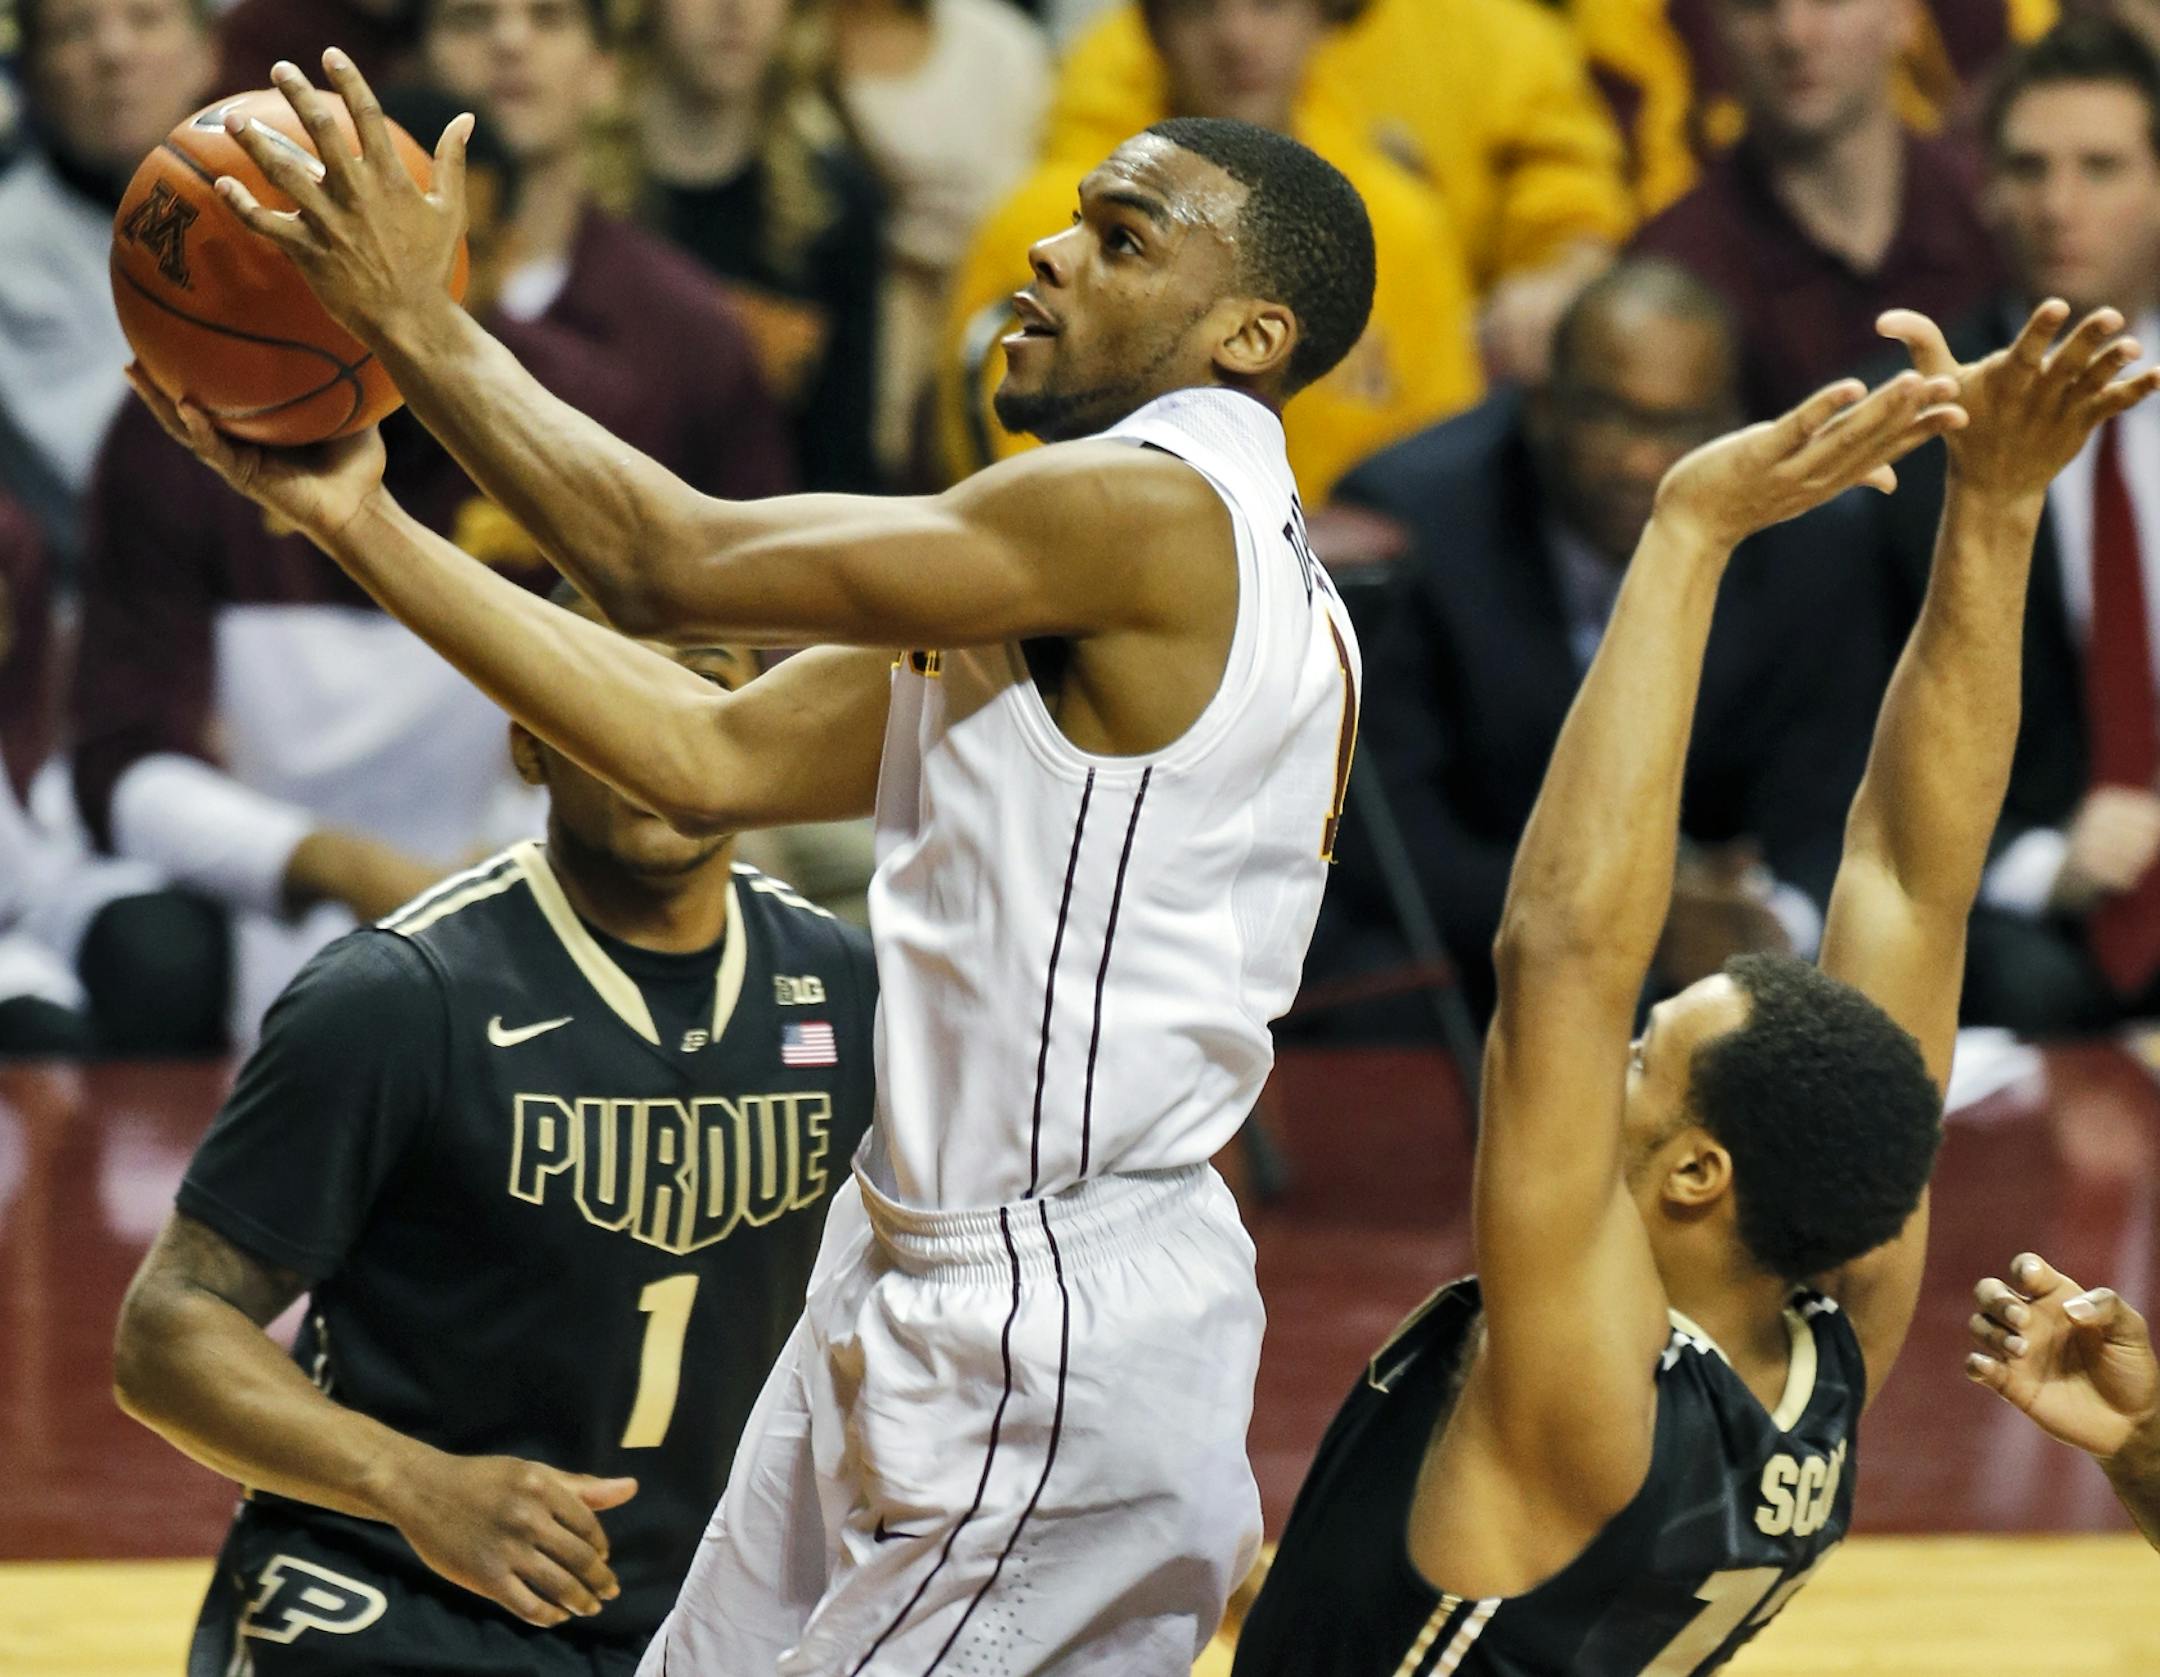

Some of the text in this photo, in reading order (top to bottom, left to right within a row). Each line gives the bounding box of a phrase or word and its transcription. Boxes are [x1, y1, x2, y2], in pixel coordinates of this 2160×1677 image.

[509, 1092, 832, 1256] PURDUE
[620, 1272, 700, 1449] 1
[1754, 1438, 1848, 1537] SC
[239, 1553, 389, 1645] P
